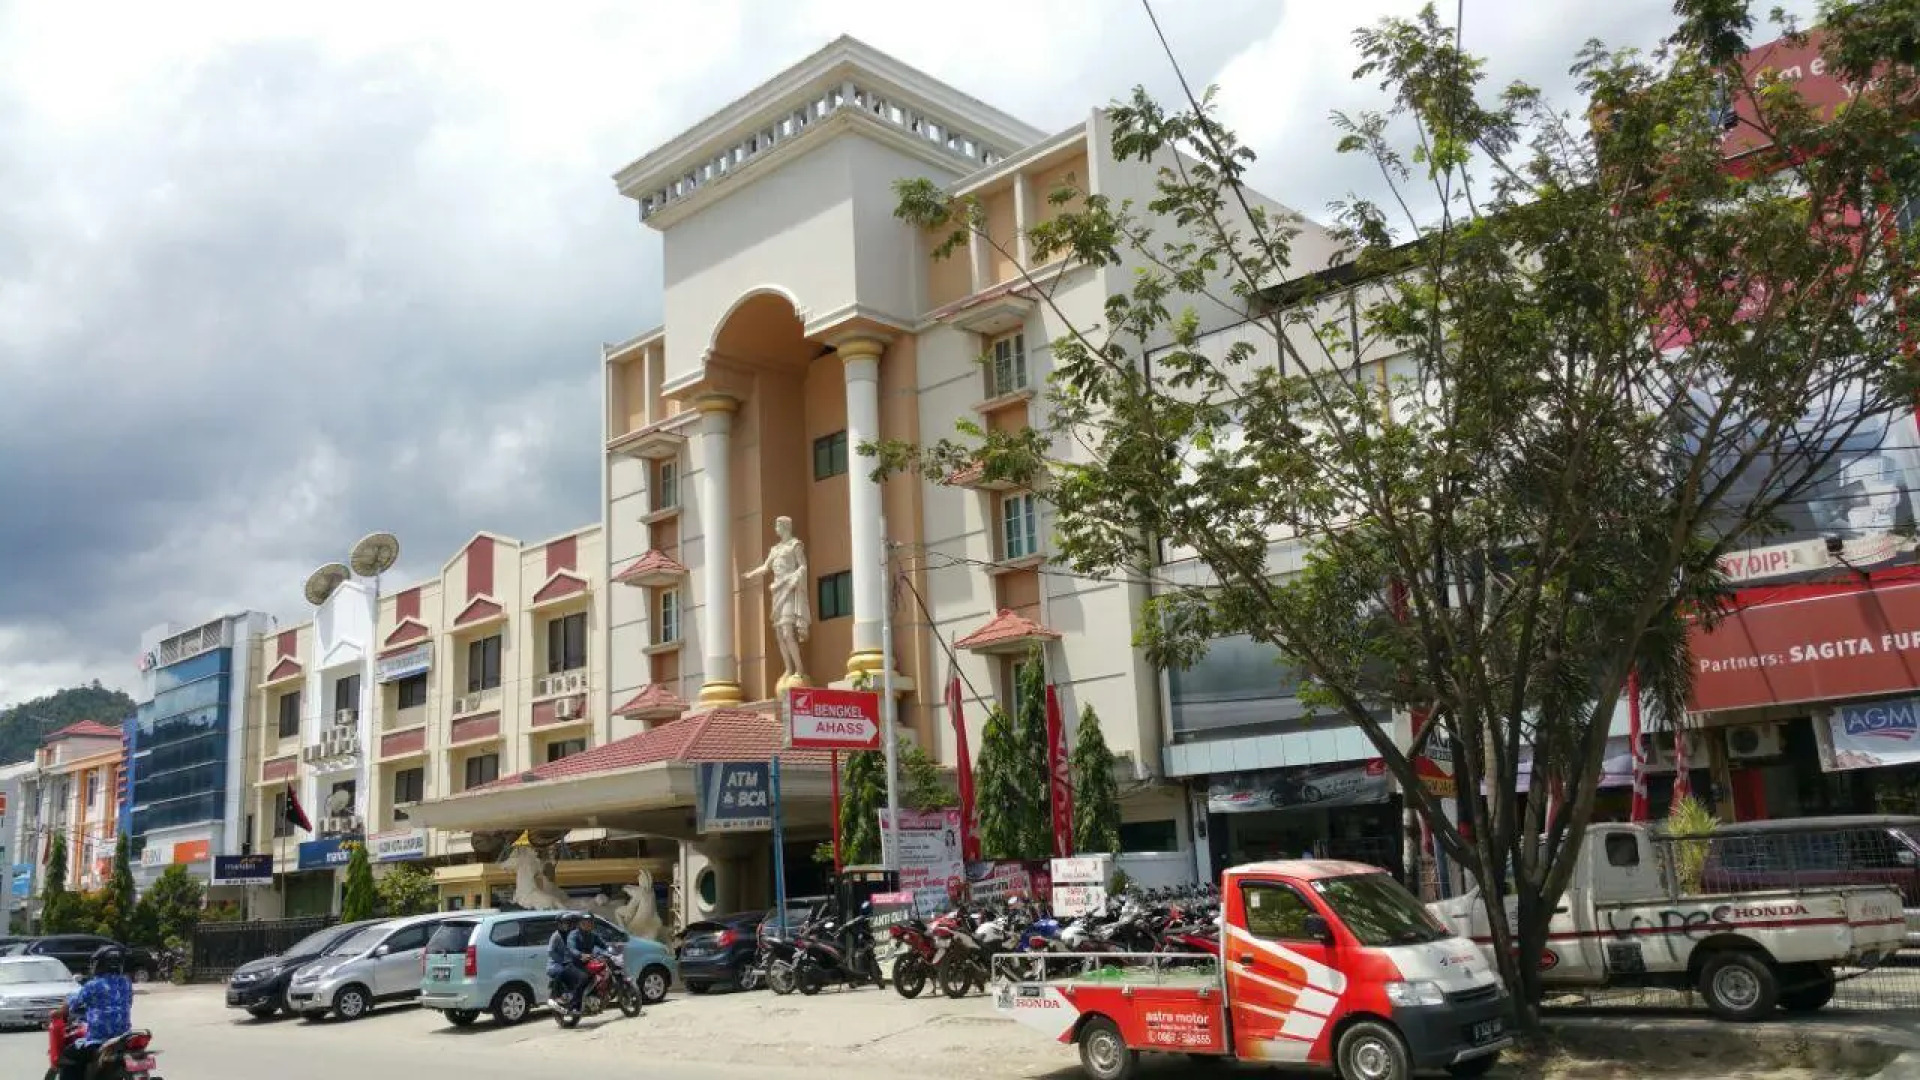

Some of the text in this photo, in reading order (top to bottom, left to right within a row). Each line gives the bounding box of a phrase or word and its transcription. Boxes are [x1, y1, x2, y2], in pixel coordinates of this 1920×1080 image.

[1749, 551, 1789, 574] DIP!
[1700, 653, 1784, 673] Partners:
[1789, 638, 1874, 662] SAGITA
[815, 704, 864, 718] BENGKEL
[1848, 705, 1913, 731] AGM
[816, 721, 864, 736] AHASS
[726, 771, 758, 787] ATM
[738, 791, 767, 807] BCA
[1734, 904, 1808, 919] HONDA
[1016, 998, 1060, 1009] HONDA
[1145, 1011, 1210, 1024] astra motor
